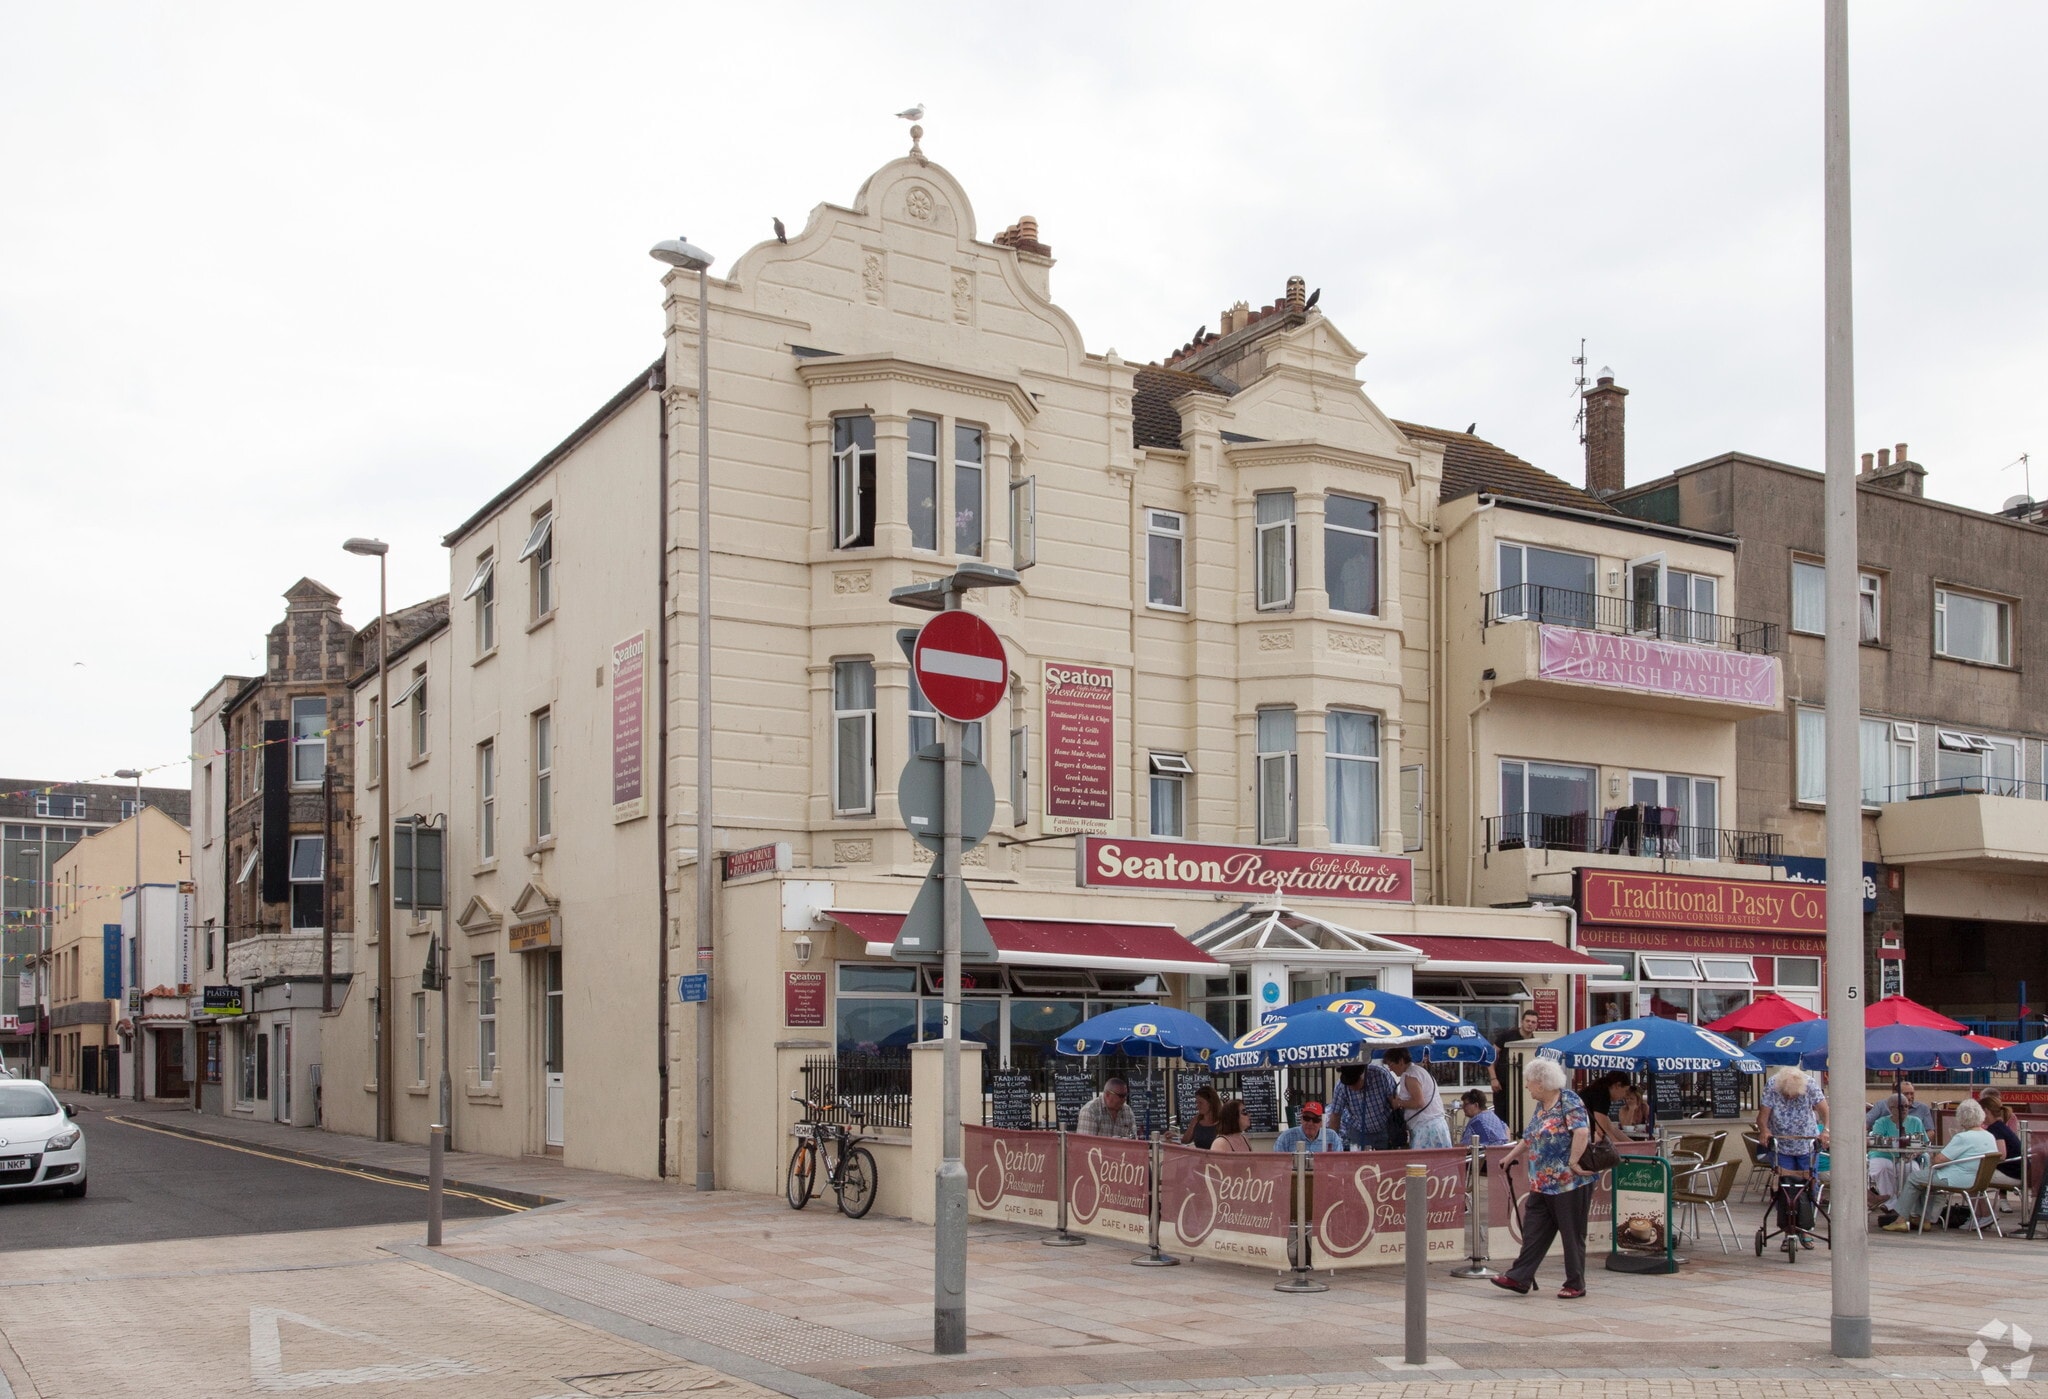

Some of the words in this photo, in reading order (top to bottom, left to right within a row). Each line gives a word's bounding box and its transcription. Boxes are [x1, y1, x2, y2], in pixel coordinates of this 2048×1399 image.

[614, 641, 643, 675] Seaton
[1570, 636, 1648, 663] AWARD
[1660, 649, 1751, 677] WINNING
[1046, 667, 1113, 690] Seaton
[1565, 656, 1661, 686] CORNISH
[1672, 670, 1753, 698] PASTIES
[1045, 682, 1112, 700] Restaurant
[1047, 698, 1071, 707] Traditional
[1071, 700, 1085, 708] Home
[1101, 703, 1112, 711] food
[1051, 711, 1078, 720] Traditional
[1077, 713, 1090, 721] Fish
[1095, 716, 1110, 724] Chips
[1085, 726, 1100, 734] Grills
[1054, 748, 1070, 756] Home
[1085, 751, 1106, 759] Specials
[1054, 761, 1075, 769] Burgers
[1081, 763, 1106, 771] Omelettes
[1053, 785, 1070, 793] Cream
[1053, 818, 1080, 826] Families
[1081, 819, 1108, 827] Welcome
[734, 852, 750, 866] DINE
[753, 847, 772, 861] DRINK
[733, 863, 753, 877] RELAX
[755, 858, 774, 872] ENJOY
[1097, 844, 1224, 884] Seaton
[1221, 853, 1400, 894] Restaurant
[1343, 859, 1375, 876] Bar
[1377, 863, 1390, 876] &
[1608, 879, 1724, 914] Traditional
[1731, 887, 1785, 924] Pasty
[1790, 891, 1824, 920] Co.
[1609, 908, 1641, 918] AWARD
[1644, 909, 1684, 921] WINNING
[1686, 912, 1725, 923] CORNISH
[1727, 914, 1761, 925] PASTIES
[1581, 929, 1626, 944] COFFEE
[1629, 931, 1668, 946] HOUSE
[1685, 935, 1725, 948] CREAM
[1728, 937, 1755, 949] TEAS
[1772, 939, 1790, 950] ICE
[789, 973, 821, 984] Seaton
[1848, 986, 1858, 999] 5
[1215, 1051, 1260, 1070] FOSTER'S
[1278, 1043, 1350, 1063] FOSTER'S
[1573, 1054, 1636, 1070] FOSTER'S
[1177, 1074, 1193, 1082] FISH
[2011, 1093, 2028, 1101] AREA
[7, 1160, 26, 1169] NKP
[976, 1139, 1046, 1206] Seaton
[1005, 1172, 1046, 1194] Restaurant
[1072, 1147, 1145, 1221] Seaton
[1101, 1184, 1146, 1209] Restaurant
[1178, 1163, 1274, 1242] Seaton
[1005, 1204, 1021, 1214] CAFE
[1029, 1207, 1044, 1217] BAR
[1218, 1202, 1273, 1229] Restaurant
[1320, 1164, 1457, 1253] Seaon
[1376, 1204, 1457, 1227] Resrant
[1102, 1218, 1121, 1230] CAFE
[1128, 1223, 1144, 1235] BAR
[1215, 1241, 1238, 1252] CAFE
[1248, 1246, 1268, 1256] BAR
[1380, 1243, 1405, 1254] CAF
[1429, 1240, 1454, 1250] BAR
